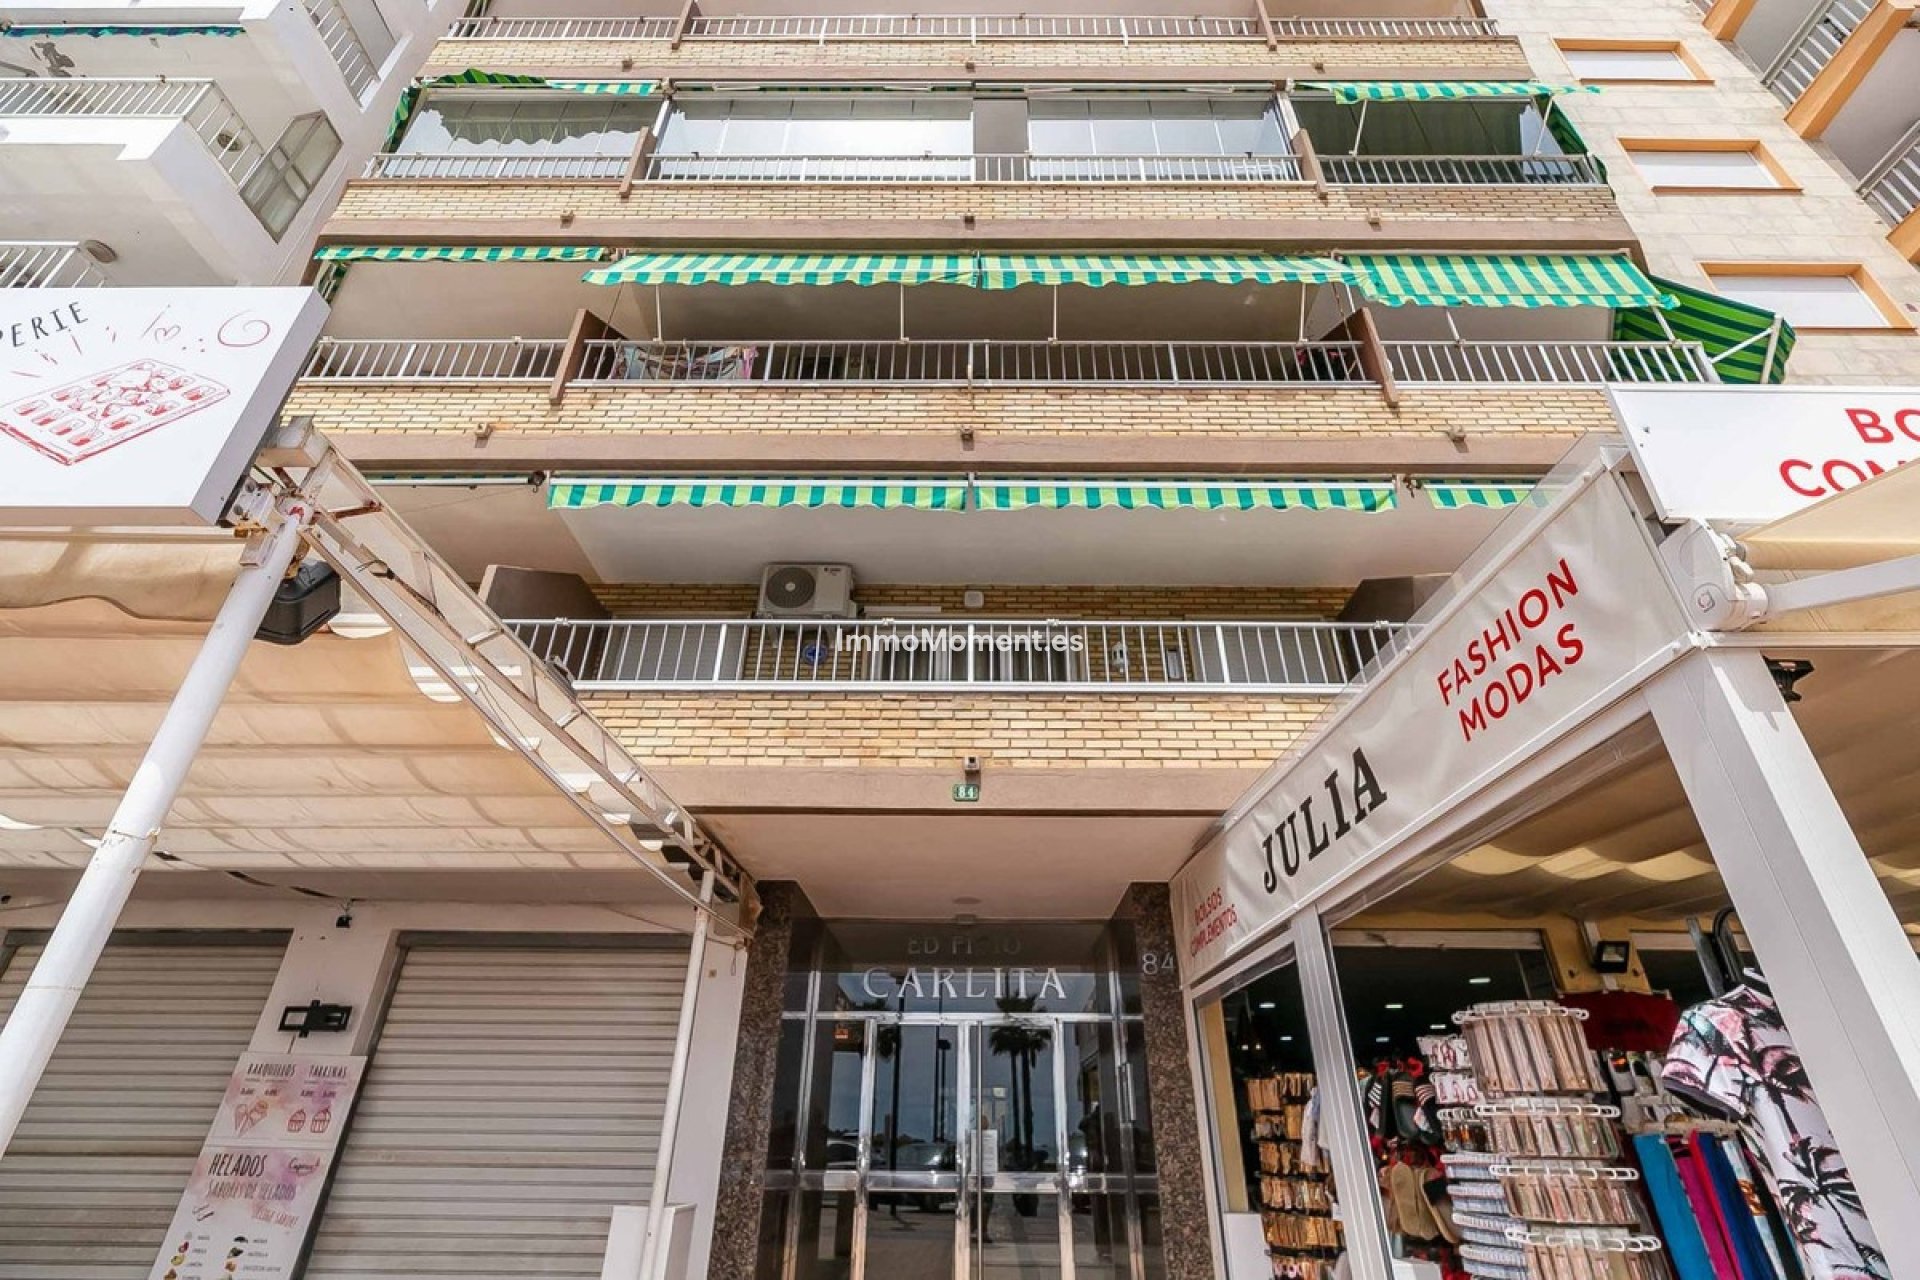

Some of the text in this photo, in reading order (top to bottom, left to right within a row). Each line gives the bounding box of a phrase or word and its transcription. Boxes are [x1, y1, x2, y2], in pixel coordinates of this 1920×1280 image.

[1778, 458, 1907, 497] CO
[1436, 557, 1580, 707] FASHION
[1458, 622, 1585, 742] MODAS
[1261, 746, 1388, 894] JULIA
[862, 966, 1067, 1000] CARLITA
[1142, 952, 1176, 975] 84
[207, 1153, 268, 1177] HELADOS
